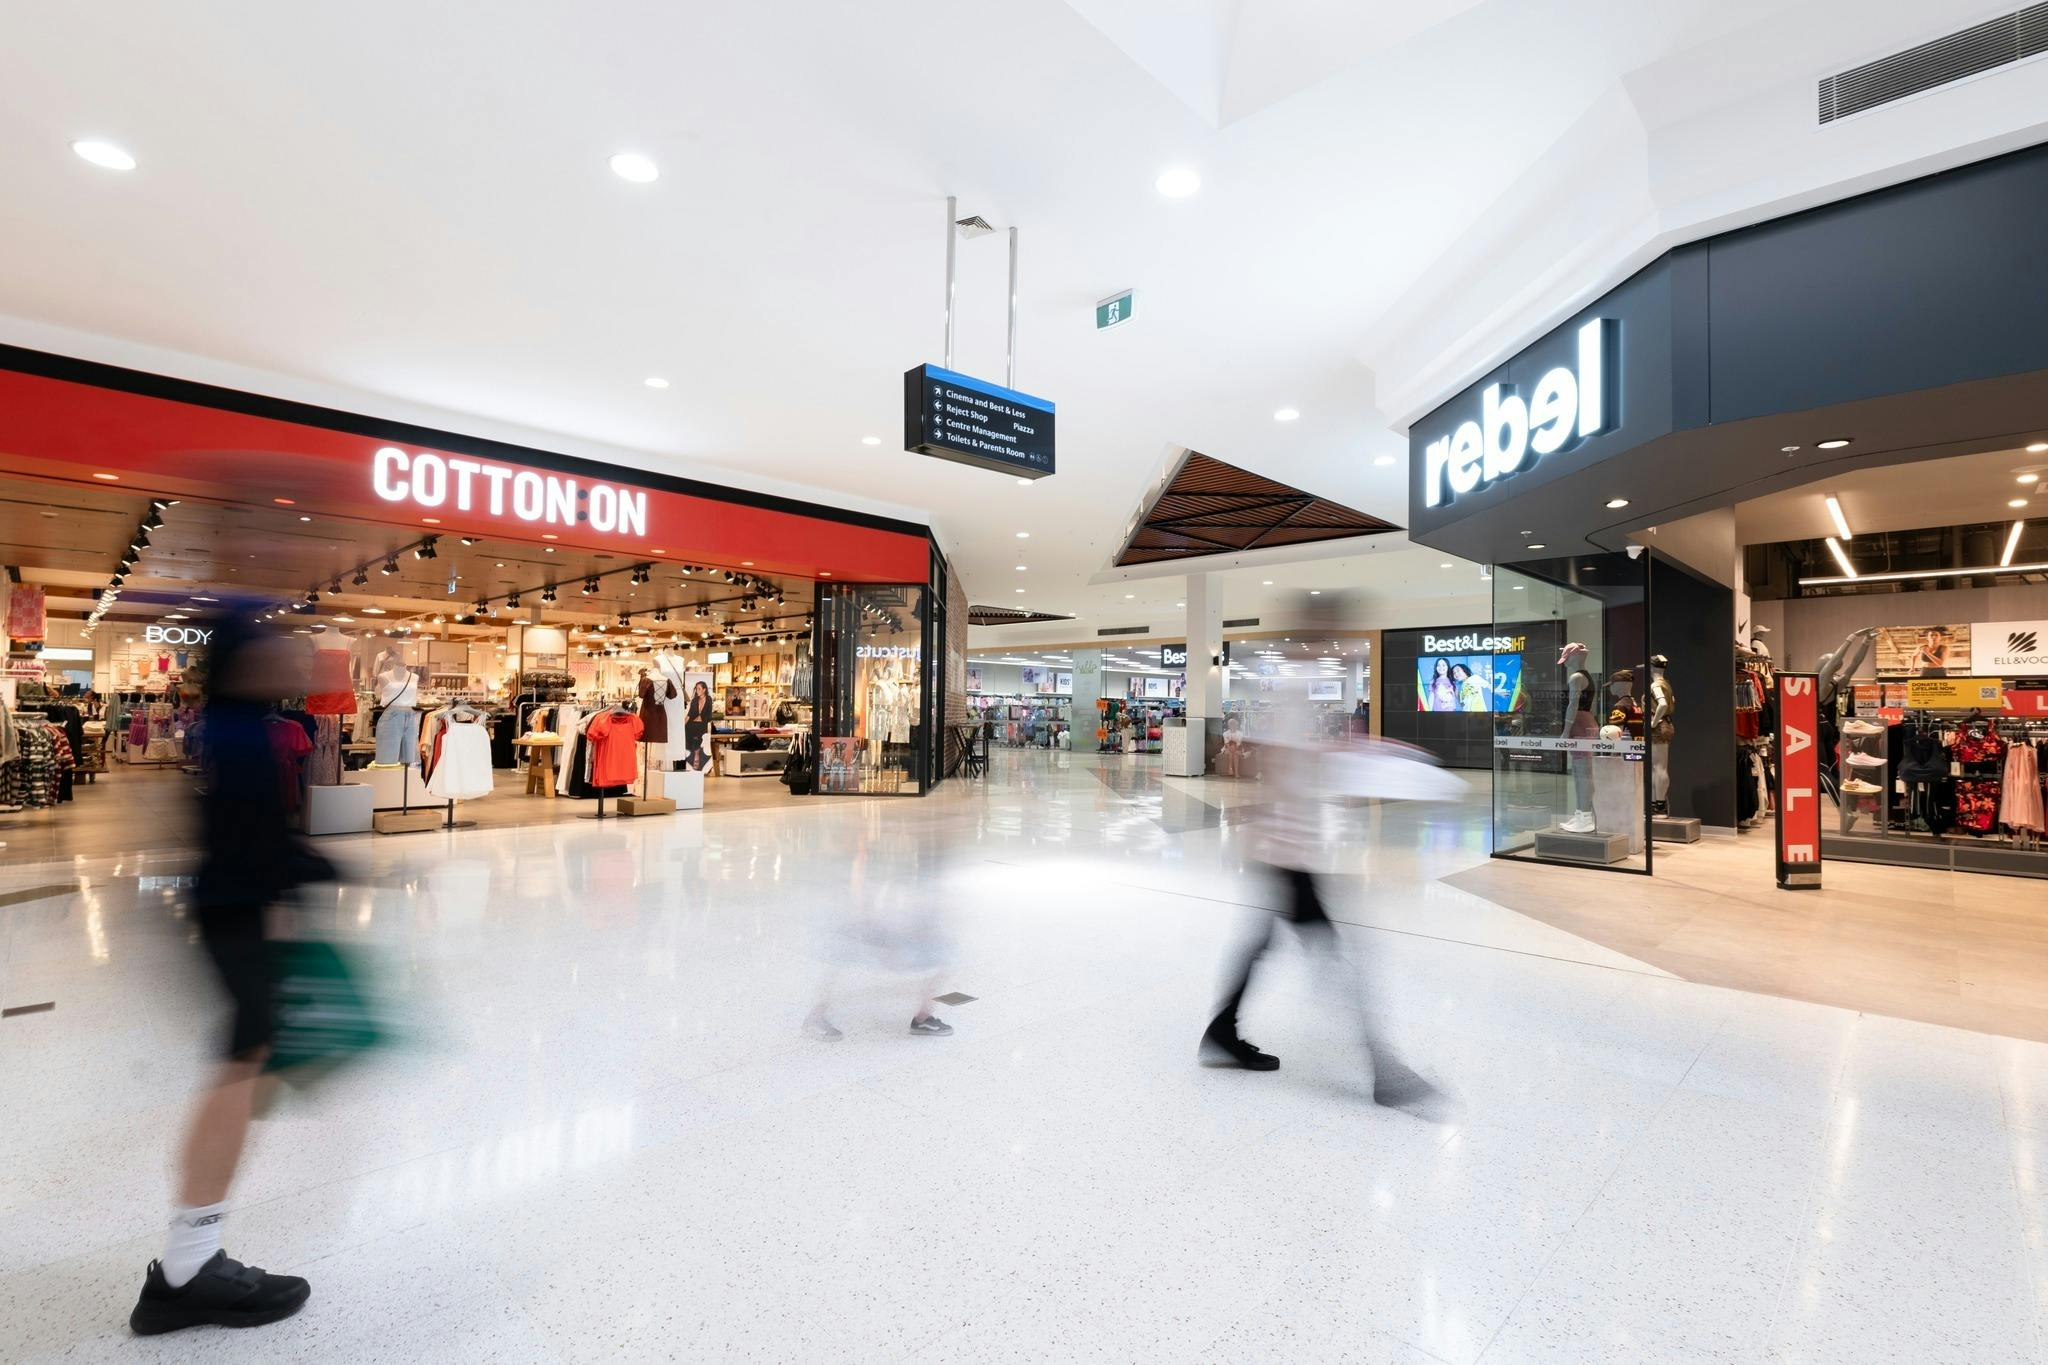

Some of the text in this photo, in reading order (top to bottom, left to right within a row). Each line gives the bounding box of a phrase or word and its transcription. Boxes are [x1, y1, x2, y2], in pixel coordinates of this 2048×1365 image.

[946, 389, 1026, 419] Cinema and Best & Less
[946, 404, 988, 423] Reject Shop
[1426, 317, 1601, 508] rebel
[946, 419, 1017, 443] Centre Management
[1013, 422, 1034, 435] Piazza
[946, 432, 1025, 459] Toilets & Parents Room
[146, 625, 213, 645] BODY
[1424, 633, 1512, 653] Best&Less
[1163, 648, 1187, 664] Bes
[1555, 741, 1578, 749] rebel
[1784, 677, 1814, 862] SALE
